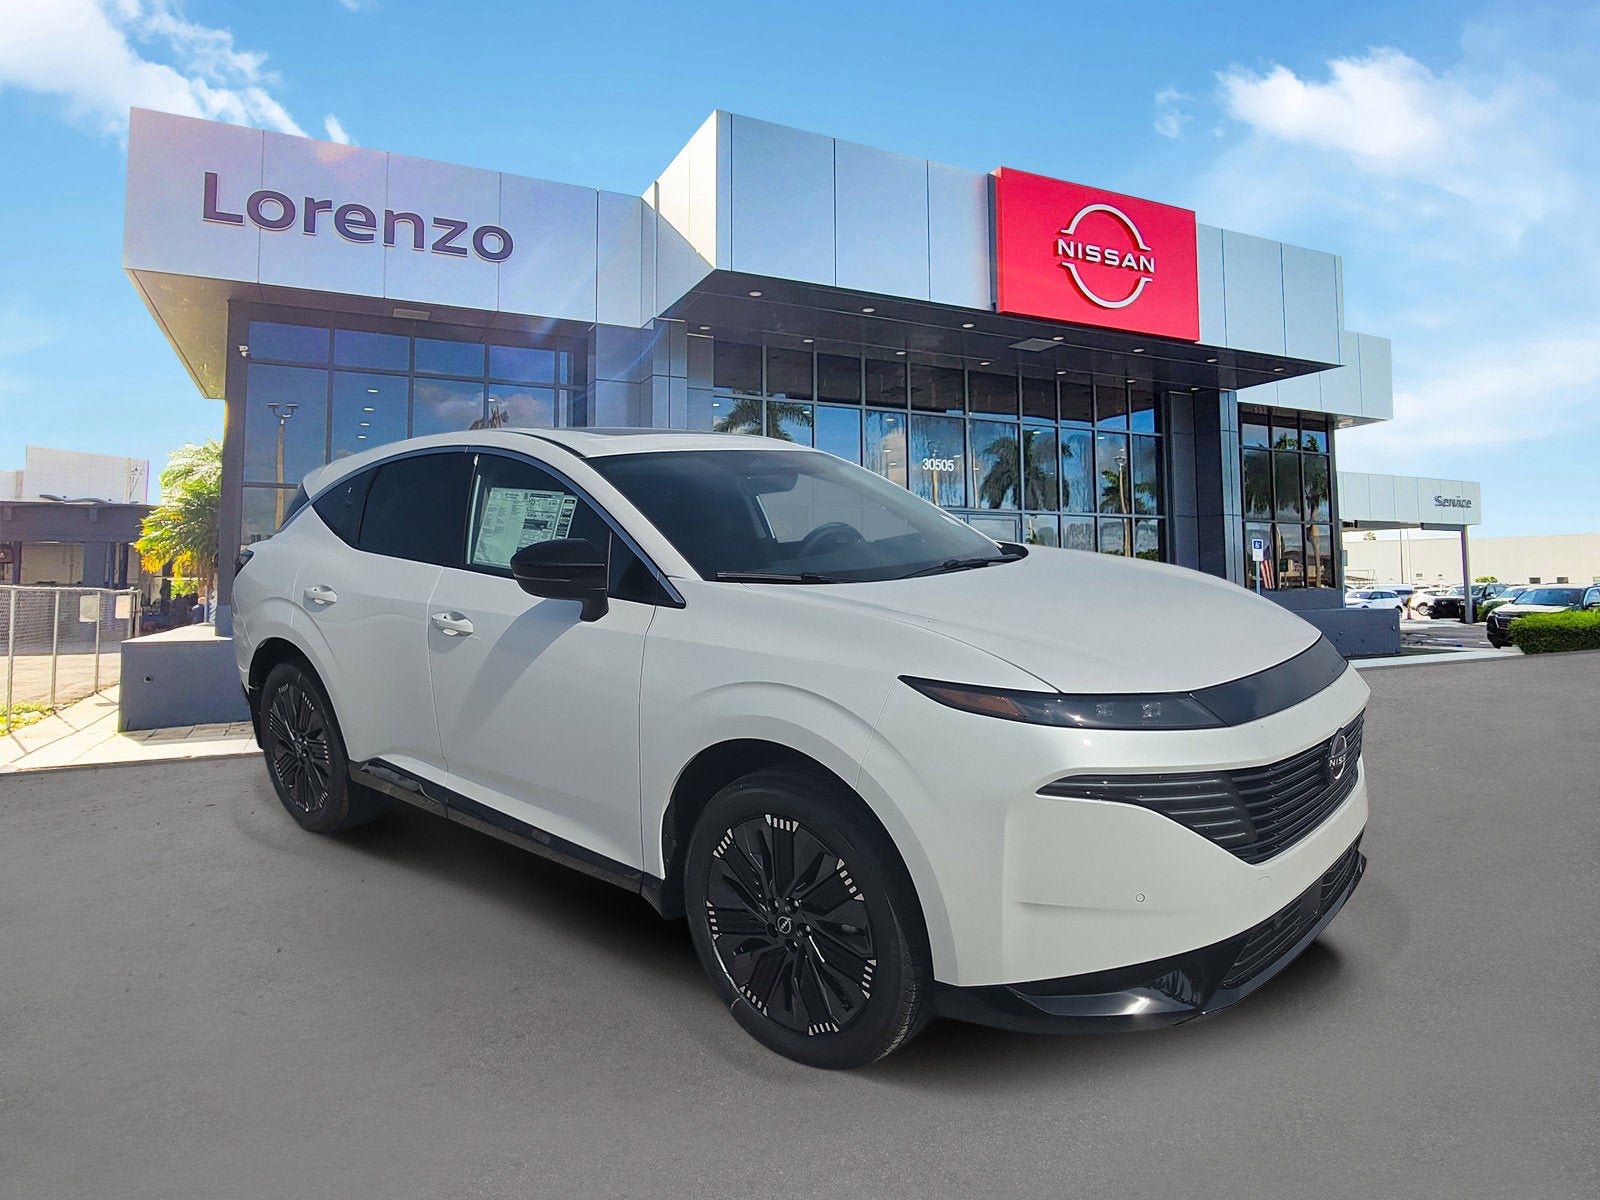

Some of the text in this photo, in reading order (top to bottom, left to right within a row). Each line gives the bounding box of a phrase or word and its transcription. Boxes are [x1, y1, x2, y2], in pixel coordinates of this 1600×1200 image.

[203, 171, 514, 262] Lorenzo
[1057, 238, 1155, 273] NISSAN
[922, 457, 955, 472] 30505
[1434, 495, 1472, 508] Service
